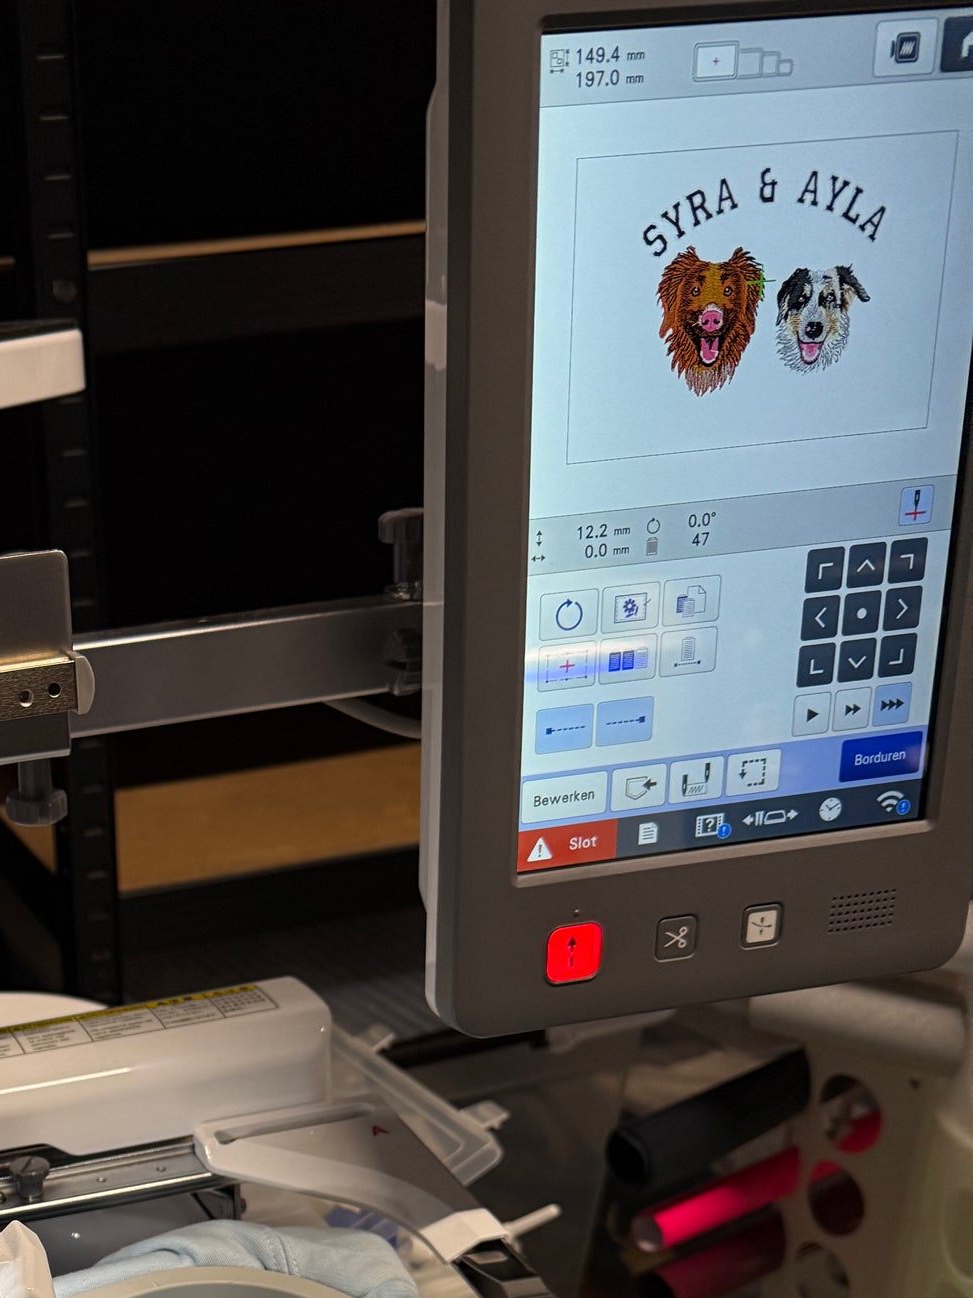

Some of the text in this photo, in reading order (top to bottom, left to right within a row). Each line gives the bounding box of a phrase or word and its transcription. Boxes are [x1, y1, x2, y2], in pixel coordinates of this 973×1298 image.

[576, 46, 645, 65] 149.4 mm
[576, 69, 644, 88] 197.0 mm
[642, 168, 887, 257] SYRA & AYLA
[577, 523, 631, 541] 12.2 mm
[691, 532, 710, 547] 47
[584, 543, 630, 559] 0.0 mm
[853, 748, 907, 766] Borduren
[532, 787, 596, 808] Bewerken
[568, 835, 598, 850] Slot
